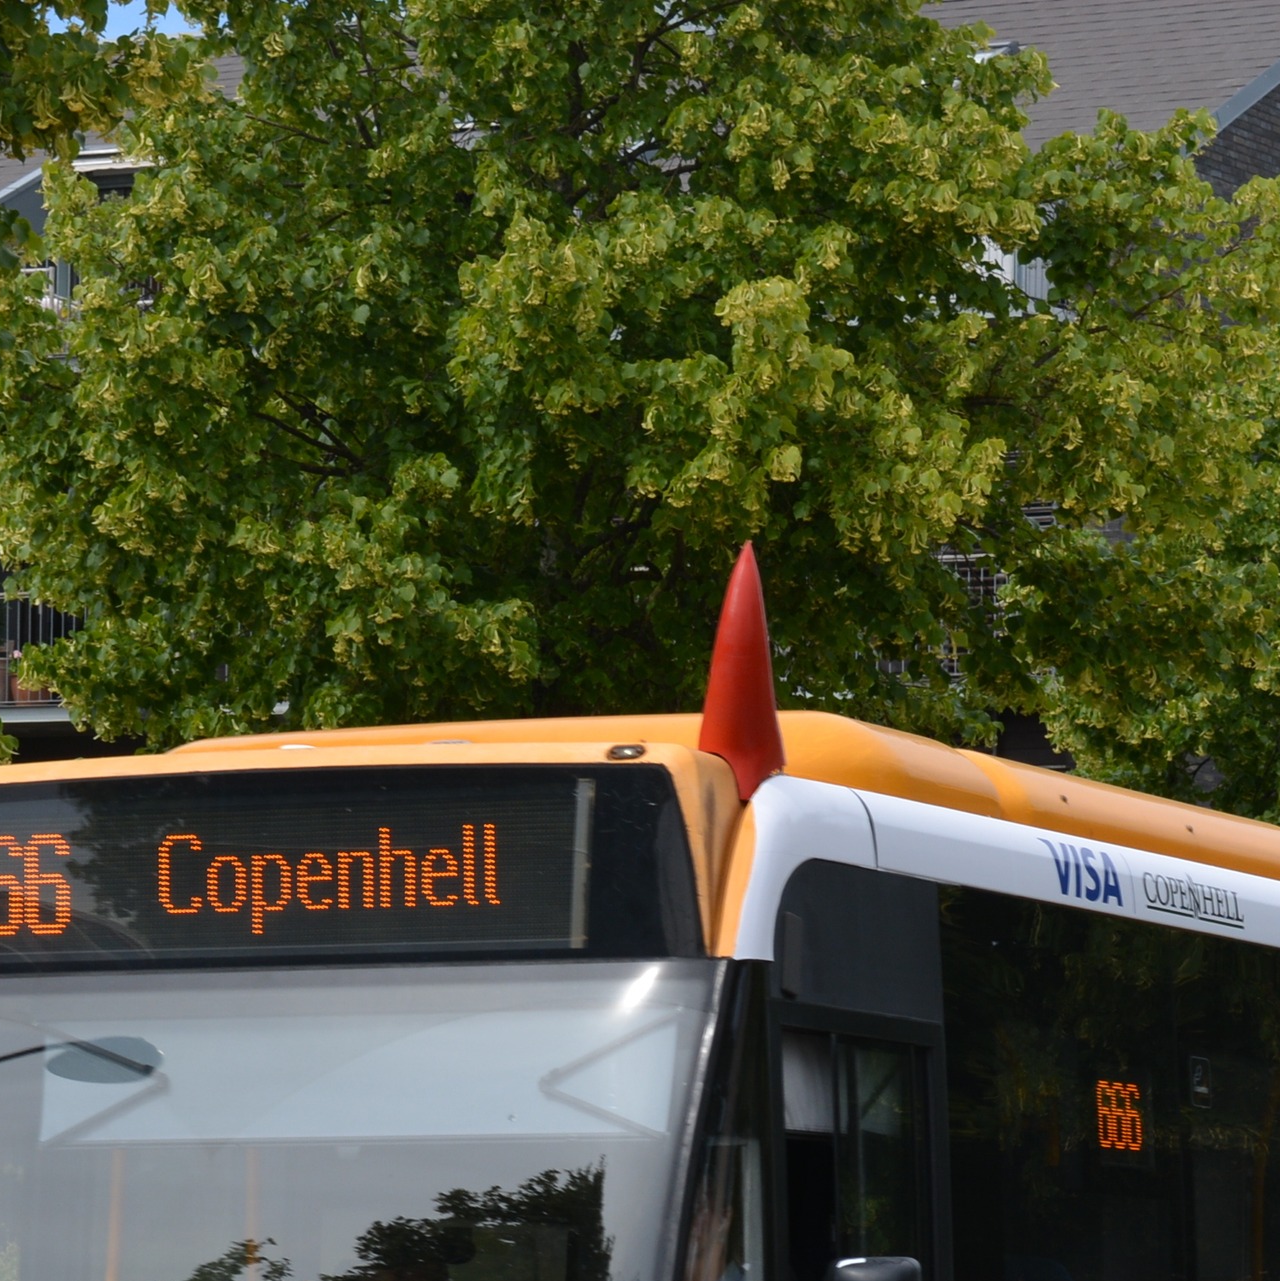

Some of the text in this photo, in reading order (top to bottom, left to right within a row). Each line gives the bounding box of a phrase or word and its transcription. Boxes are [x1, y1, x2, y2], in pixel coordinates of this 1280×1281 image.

[158, 824, 501, 935] Copenhell
[1036, 837, 1245, 923] VISA COPENHELL
[1096, 1080, 1143, 1151] 666
